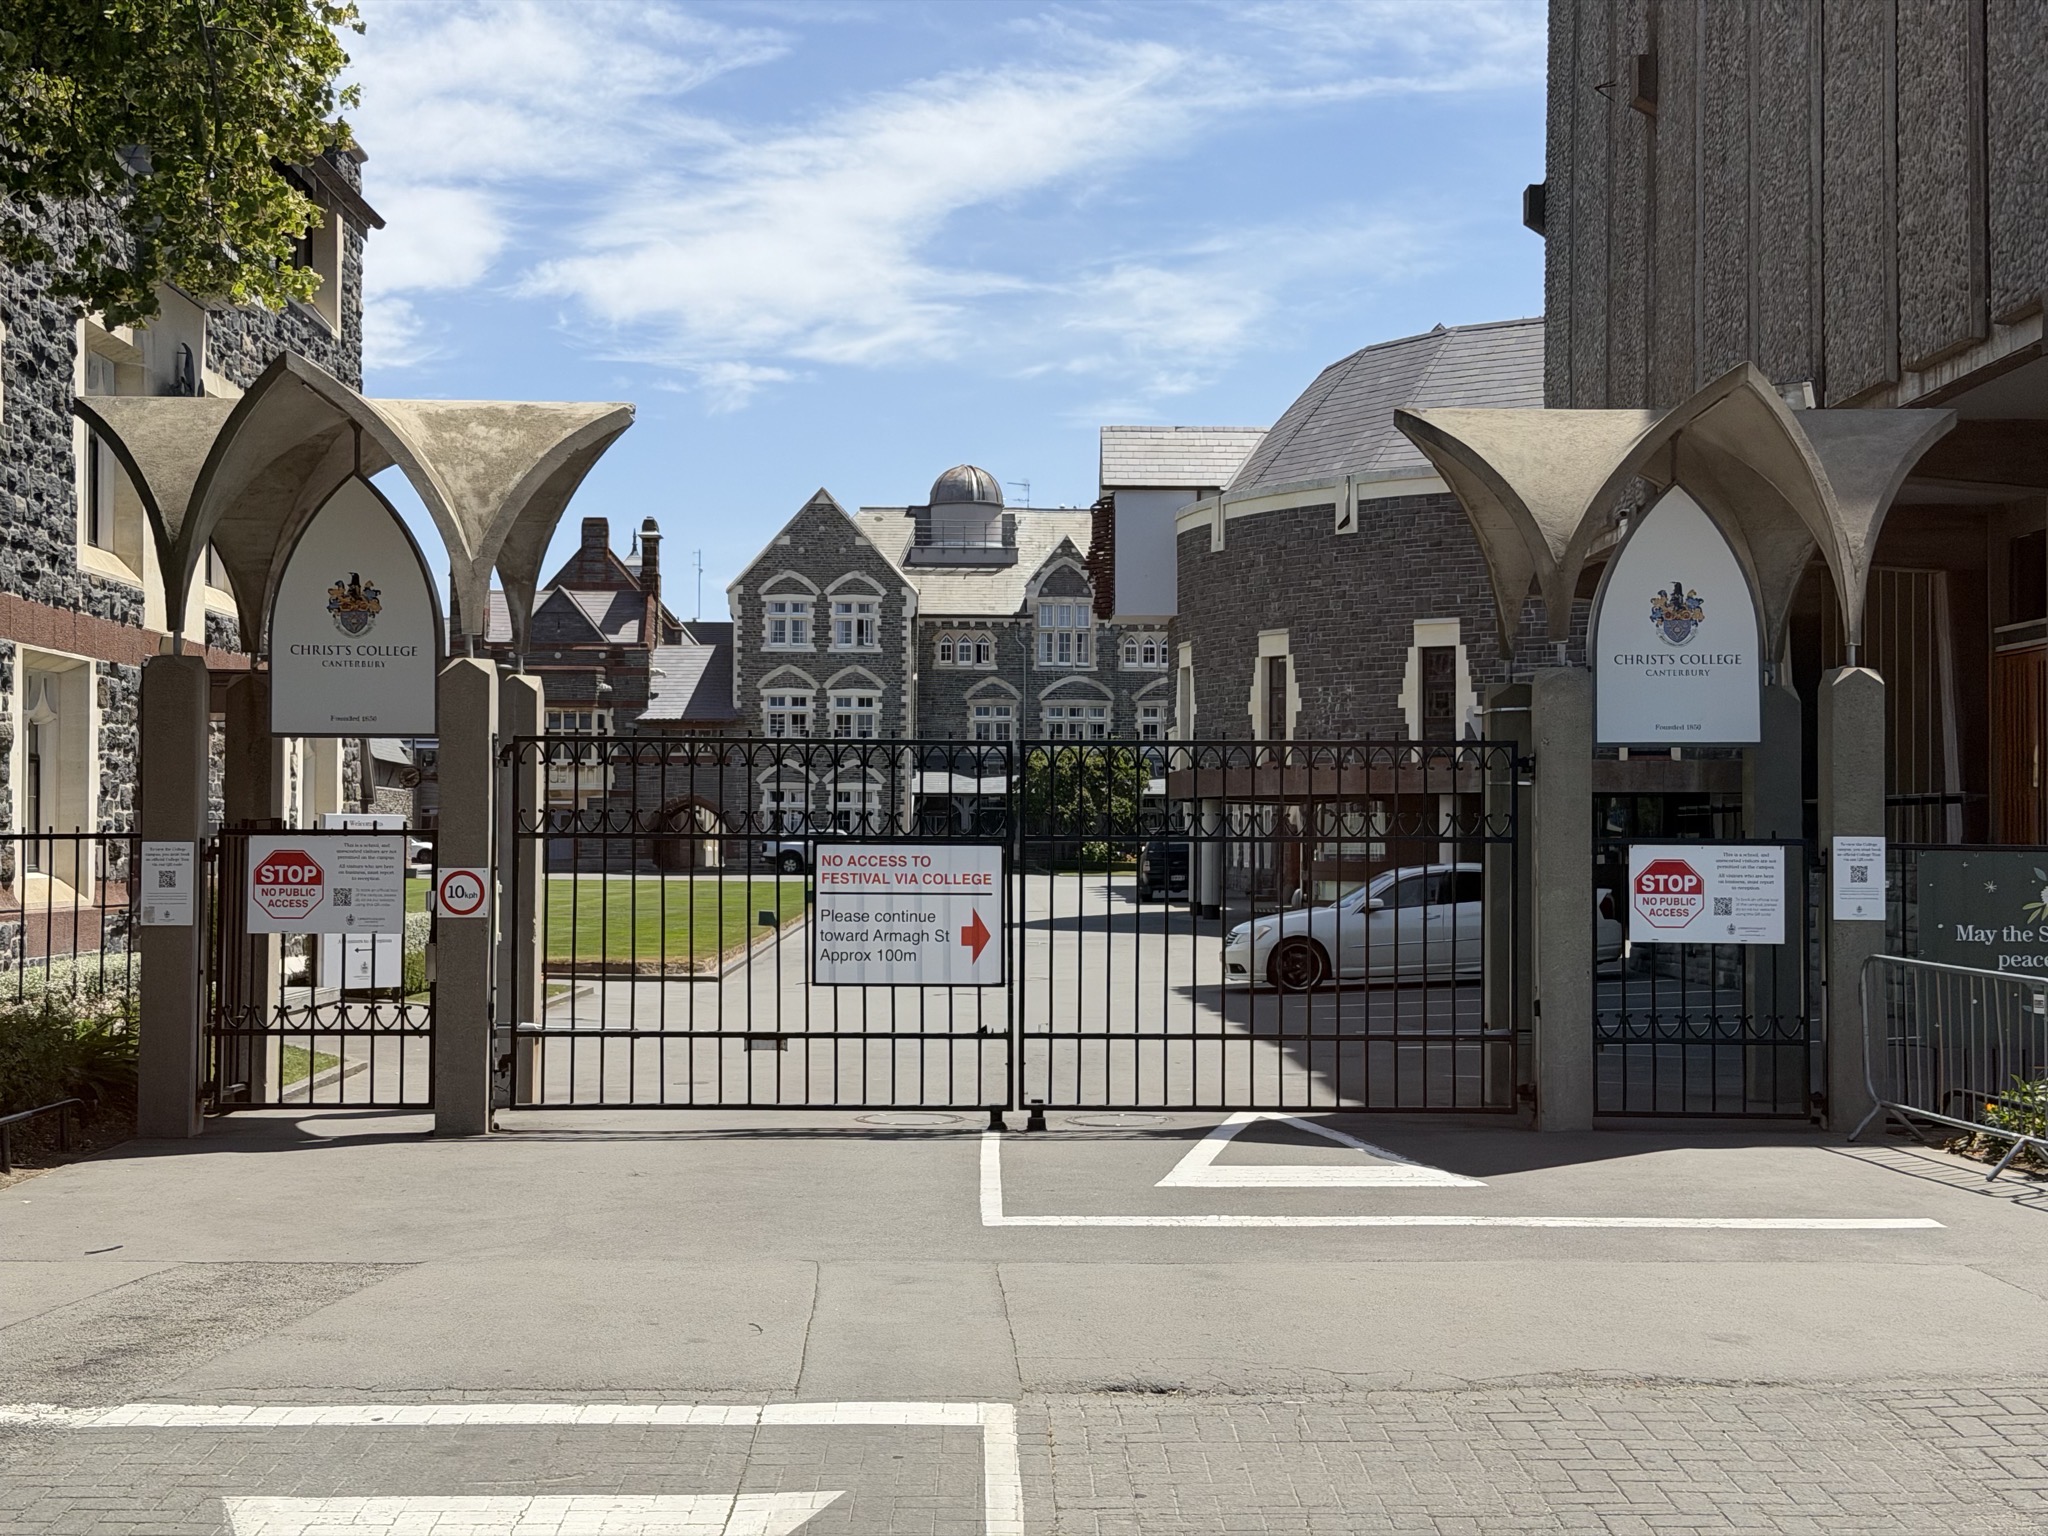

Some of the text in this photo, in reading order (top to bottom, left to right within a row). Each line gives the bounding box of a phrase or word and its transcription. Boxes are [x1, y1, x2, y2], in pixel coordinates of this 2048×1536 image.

[290, 644, 418, 657] CHRIST'S COLLEGE
[322, 660, 386, 668] CANTERBURY
[1613, 654, 1743, 665] CHRIST'S COLLEGE
[1645, 669, 1711, 677] CANTERBURY
[821, 855, 932, 867] NO ACCESS TO
[261, 865, 317, 883] STOP
[821, 872, 992, 886] FESTIVAL VIA COLLEGE
[1641, 874, 1697, 892] STOP
[261, 888, 316, 897] NO PUBLIC
[267, 899, 309, 908] ACCESS
[1642, 897, 1696, 906] NO PUBLIC
[820, 909, 936, 923] Please continue
[1649, 908, 1689, 917] ACCESS
[820, 929, 950, 945] toward Armagh St
[1955, 924, 1998, 945] May
[2002, 925, 2034, 942] the
[819, 949, 917, 964] Approx 100m
